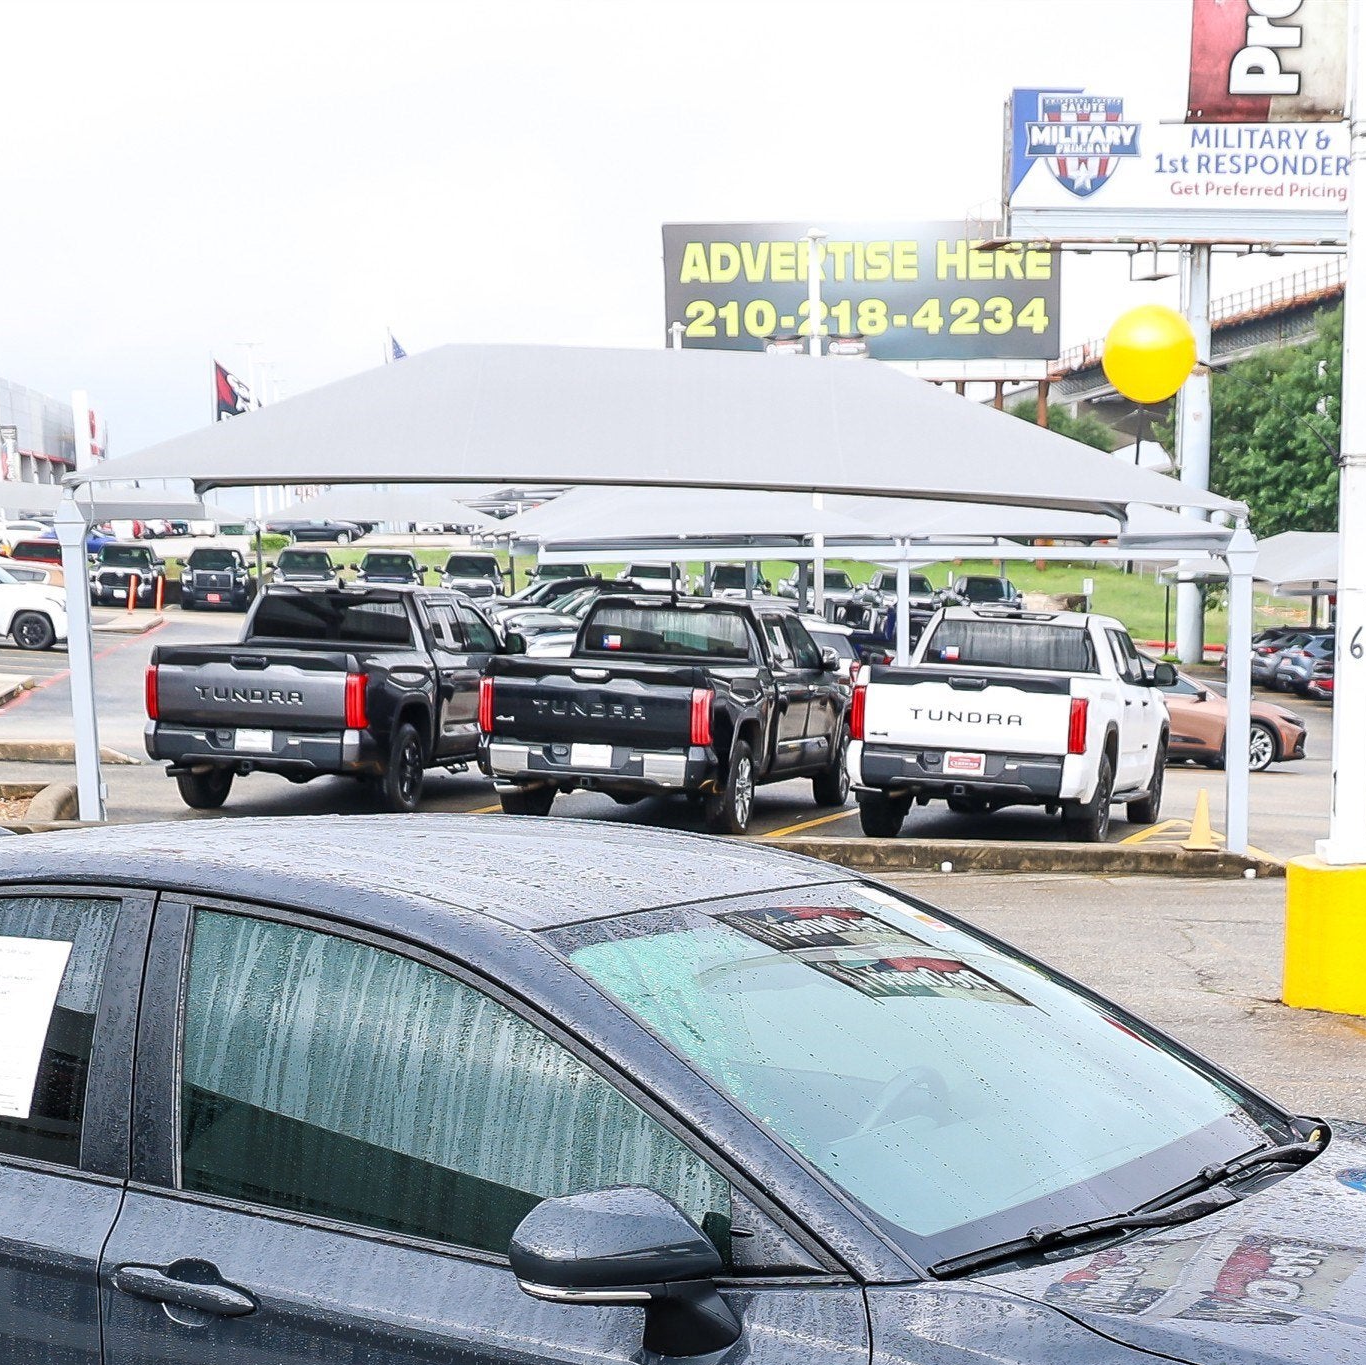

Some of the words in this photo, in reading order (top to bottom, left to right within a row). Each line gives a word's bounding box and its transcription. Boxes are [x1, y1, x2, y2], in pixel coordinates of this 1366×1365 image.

[1061, 103, 1106, 113] SALUTE
[1030, 125, 1137, 146] MILITARY
[1190, 127, 1306, 150] MILITARY
[1315, 129, 1332, 151] &
[1155, 153, 1190, 174] 1st
[1169, 181, 1200, 197] Get
[1205, 181, 1285, 198] Preferred
[1289, 182, 1349, 202] Pricing
[678, 240, 919, 283] ADVERTISE
[935, 238, 1052, 281] HERE
[683, 296, 1049, 338] 210-218-4234
[1350, 626, 1364, 660] 6
[194, 684, 304, 706] TUNDRA
[532, 699, 647, 721] TUNDRA
[909, 706, 1023, 727] TUNDRA
